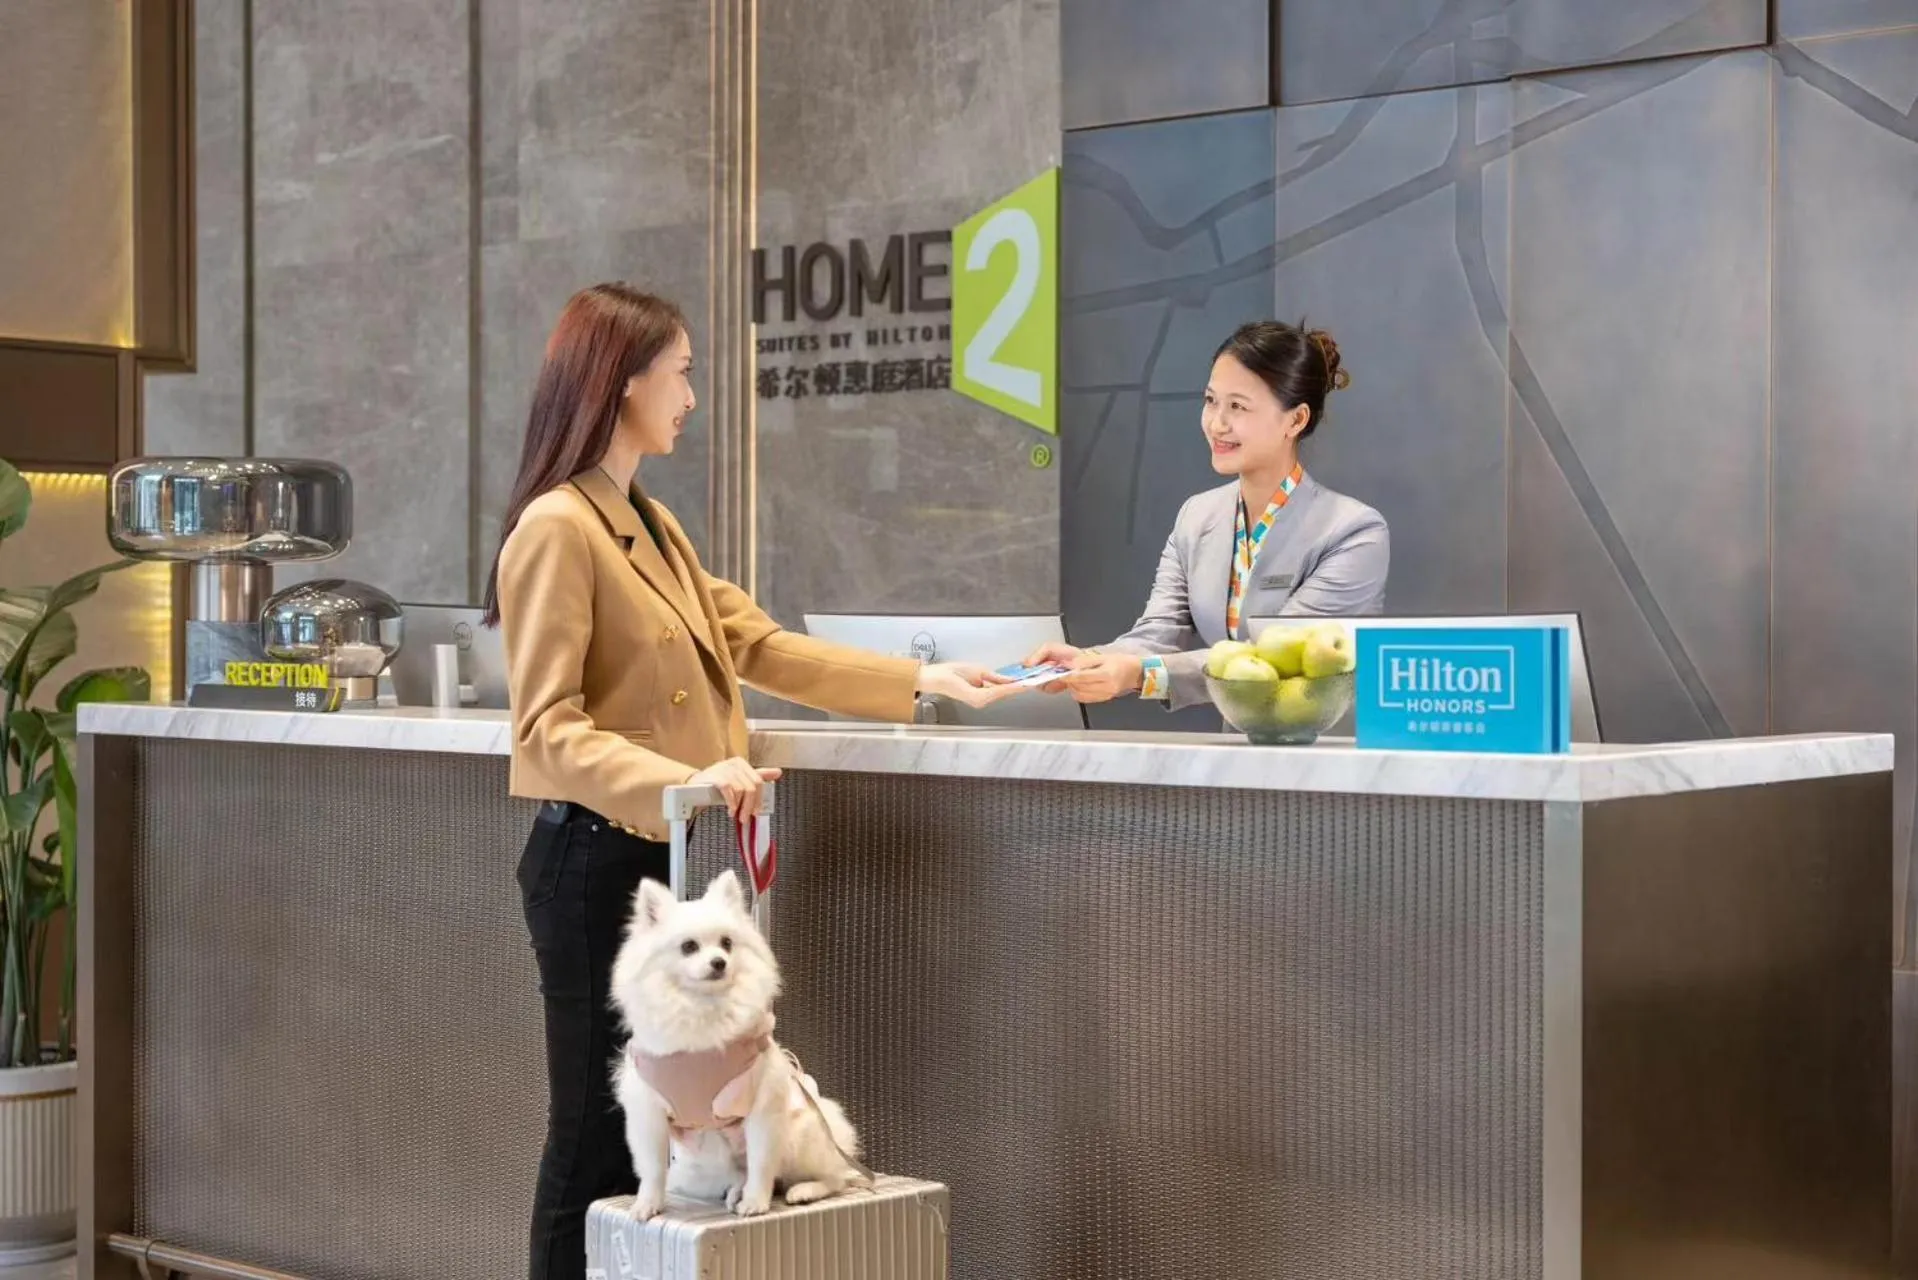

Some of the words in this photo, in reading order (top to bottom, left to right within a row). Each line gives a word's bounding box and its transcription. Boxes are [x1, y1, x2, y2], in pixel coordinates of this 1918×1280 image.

[752, 230, 952, 324] HOME
[964, 207, 1042, 409] 2
[757, 334, 820, 354] SUITES
[830, 332, 852, 349] BY
[866, 323, 952, 346] HILTON
[757, 354, 952, 400] 希尔顿惠庭酒店
[225, 661, 329, 688] RECEPTION
[1390, 657, 1503, 693] Hilton
[295, 691, 317, 708] 接待
[1407, 698, 1486, 714] HONORS
